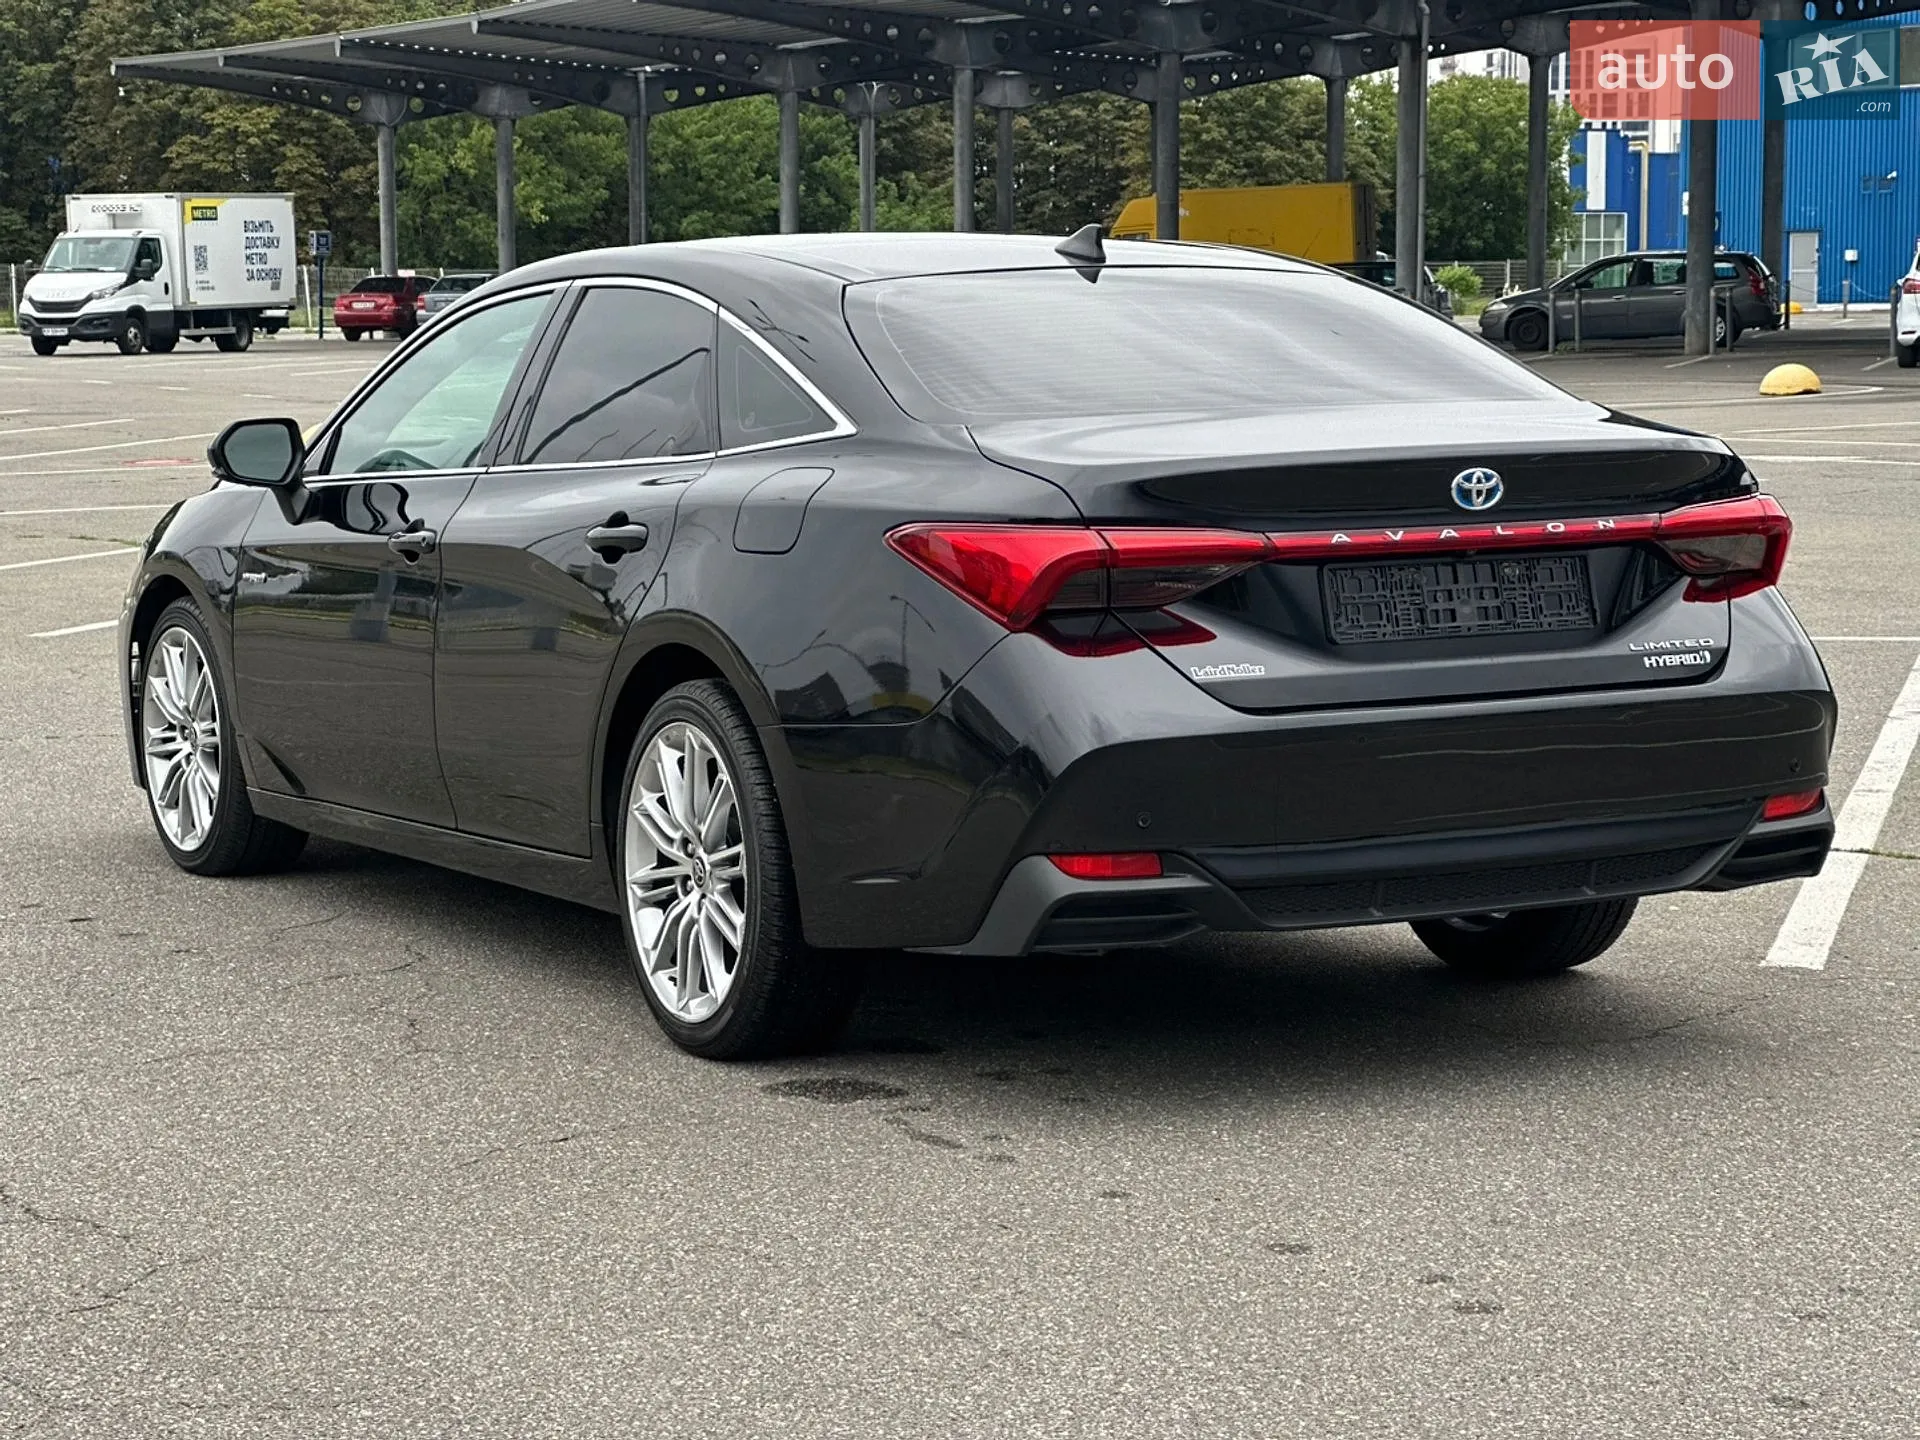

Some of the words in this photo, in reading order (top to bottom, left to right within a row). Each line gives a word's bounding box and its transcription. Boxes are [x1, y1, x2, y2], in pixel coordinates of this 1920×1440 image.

[192, 209, 217, 219] METRO
[243, 220, 274, 233] ВІЗЬМІТЬ
[245, 236, 280, 250] ДОСТАВКУ
[245, 252, 268, 265] METRO
[246, 268, 256, 281] ЗА
[256, 267, 282, 281] ОСНОВУ
[1331, 519, 1616, 544] AVALON
[1629, 638, 1714, 651] LIMITED
[1643, 653, 1701, 668] HYBRID
